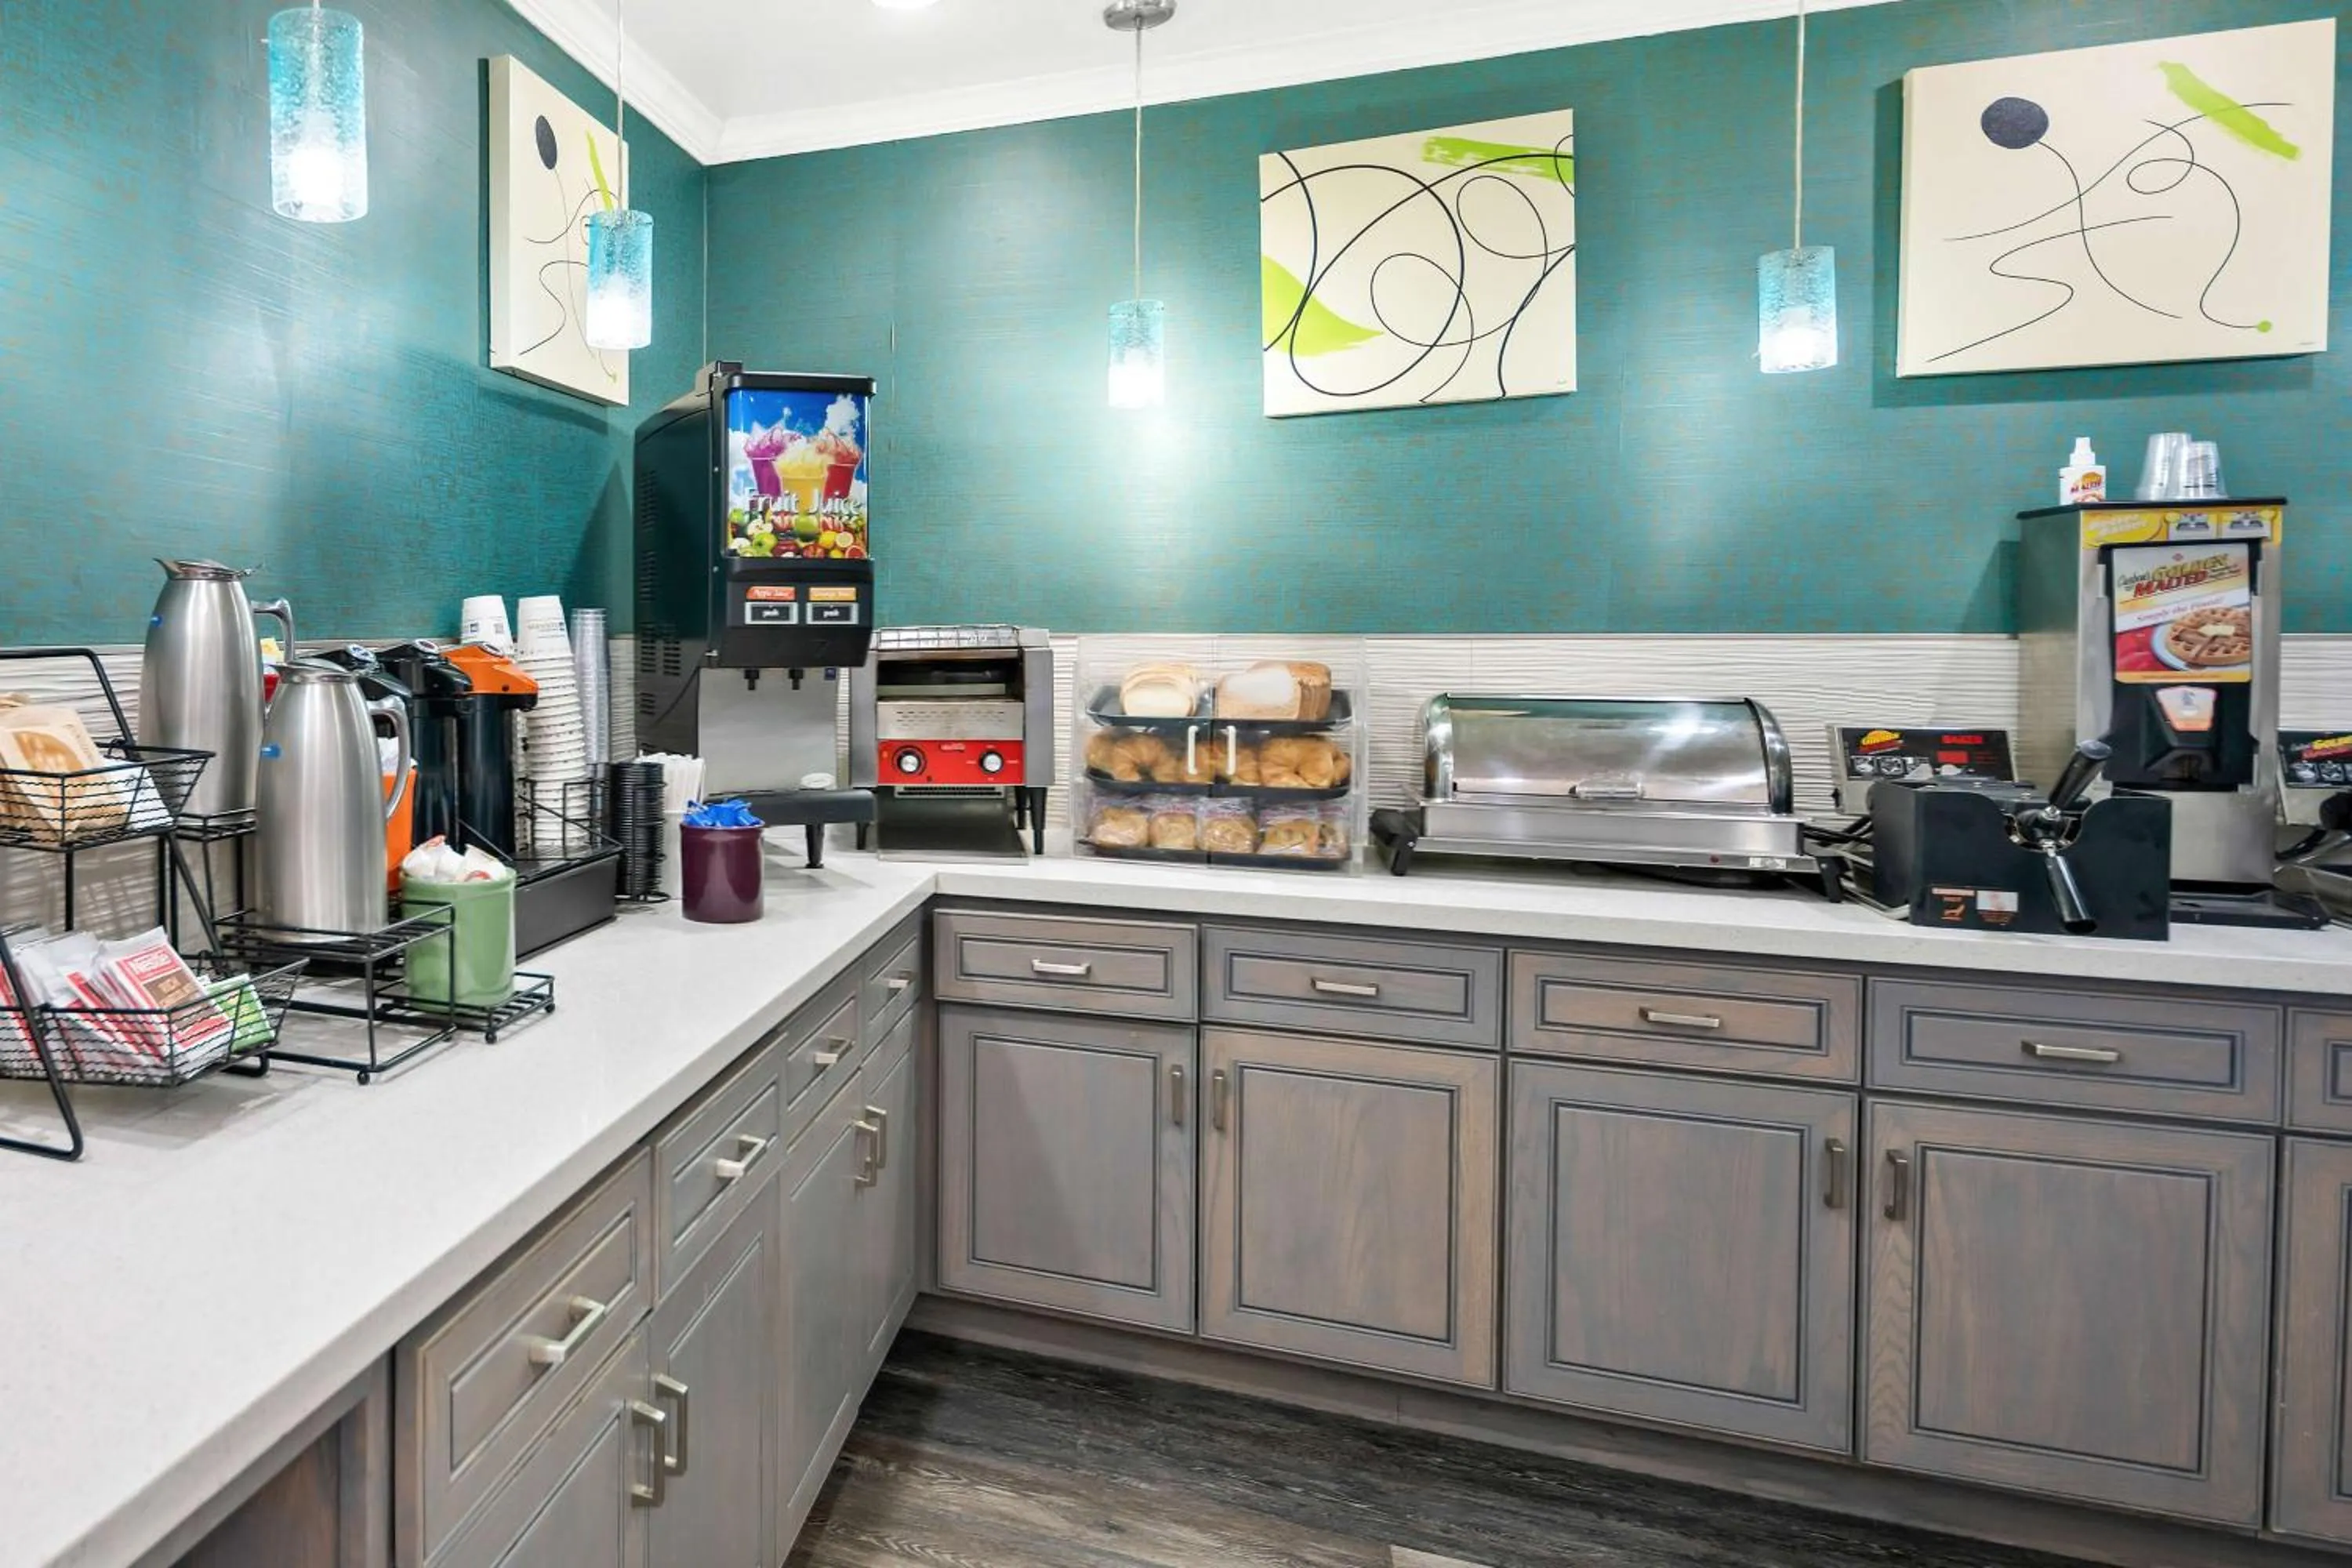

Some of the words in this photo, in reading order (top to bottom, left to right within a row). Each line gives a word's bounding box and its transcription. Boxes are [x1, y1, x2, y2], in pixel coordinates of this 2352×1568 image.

[746, 488, 800, 514] Fruit
[807, 488, 862, 515] Juice
[2151, 552, 2230, 581] GOLDEN
[2133, 569, 2209, 597] MALTED
